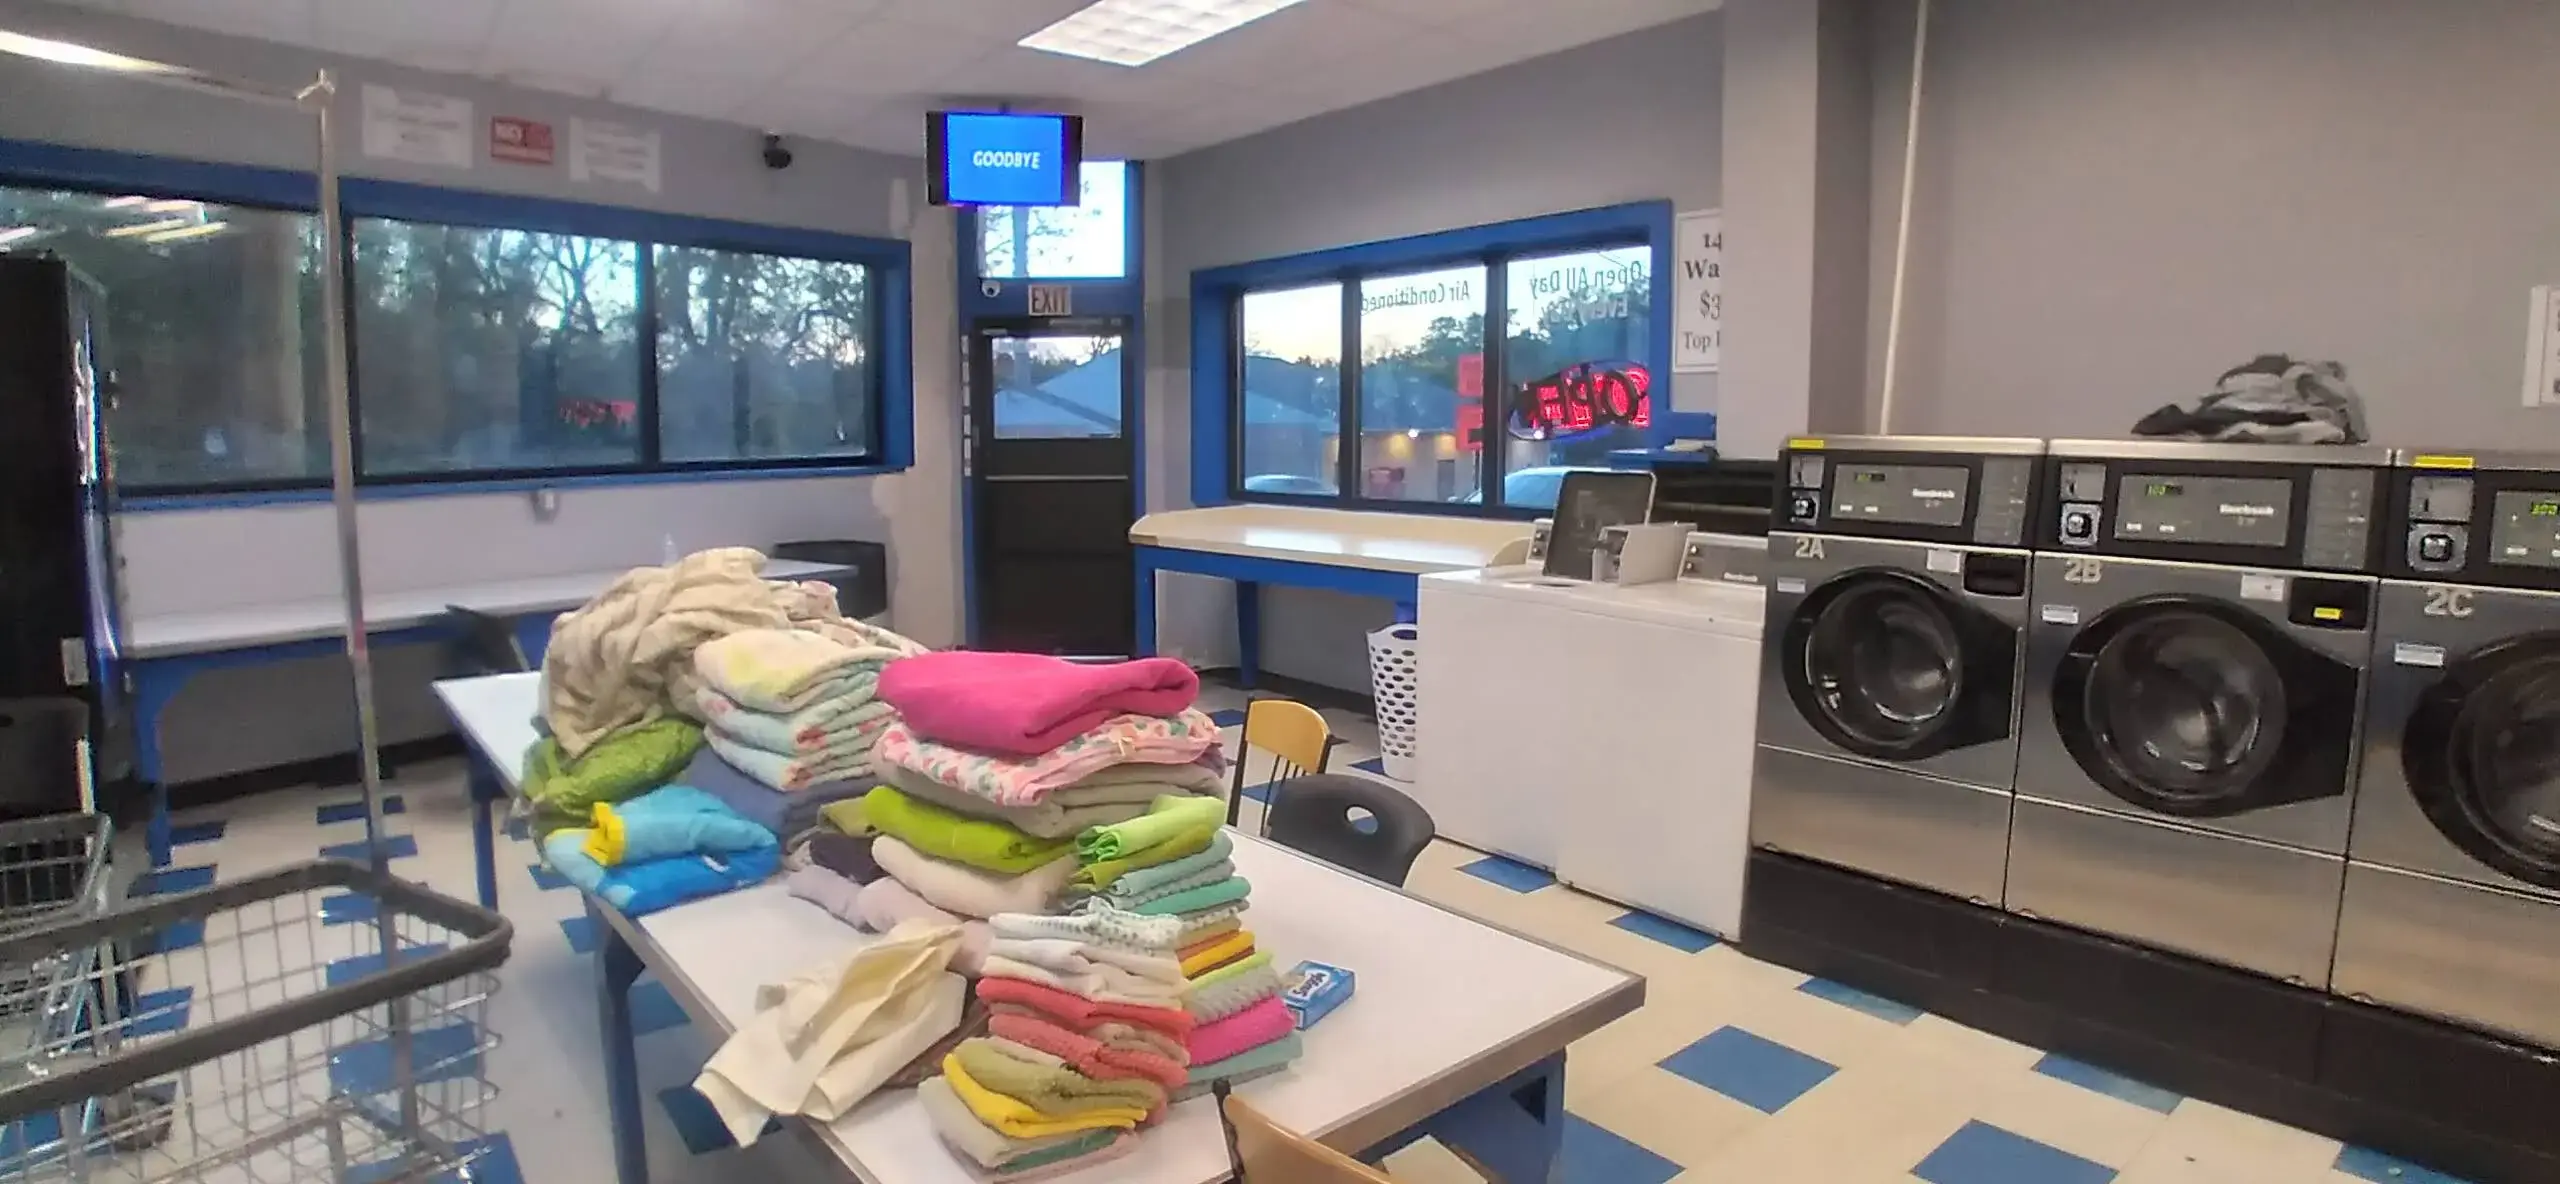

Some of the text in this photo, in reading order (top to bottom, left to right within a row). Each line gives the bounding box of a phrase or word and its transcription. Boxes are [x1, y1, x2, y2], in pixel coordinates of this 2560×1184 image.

[973, 150, 1041, 170] GOODBYE
[1031, 286, 1069, 314] EXIT
[1684, 331, 1711, 353] Top
[1795, 538, 1825, 560] 2A
[2064, 559, 2101, 583] 2B
[2424, 586, 2475, 617] 2C
